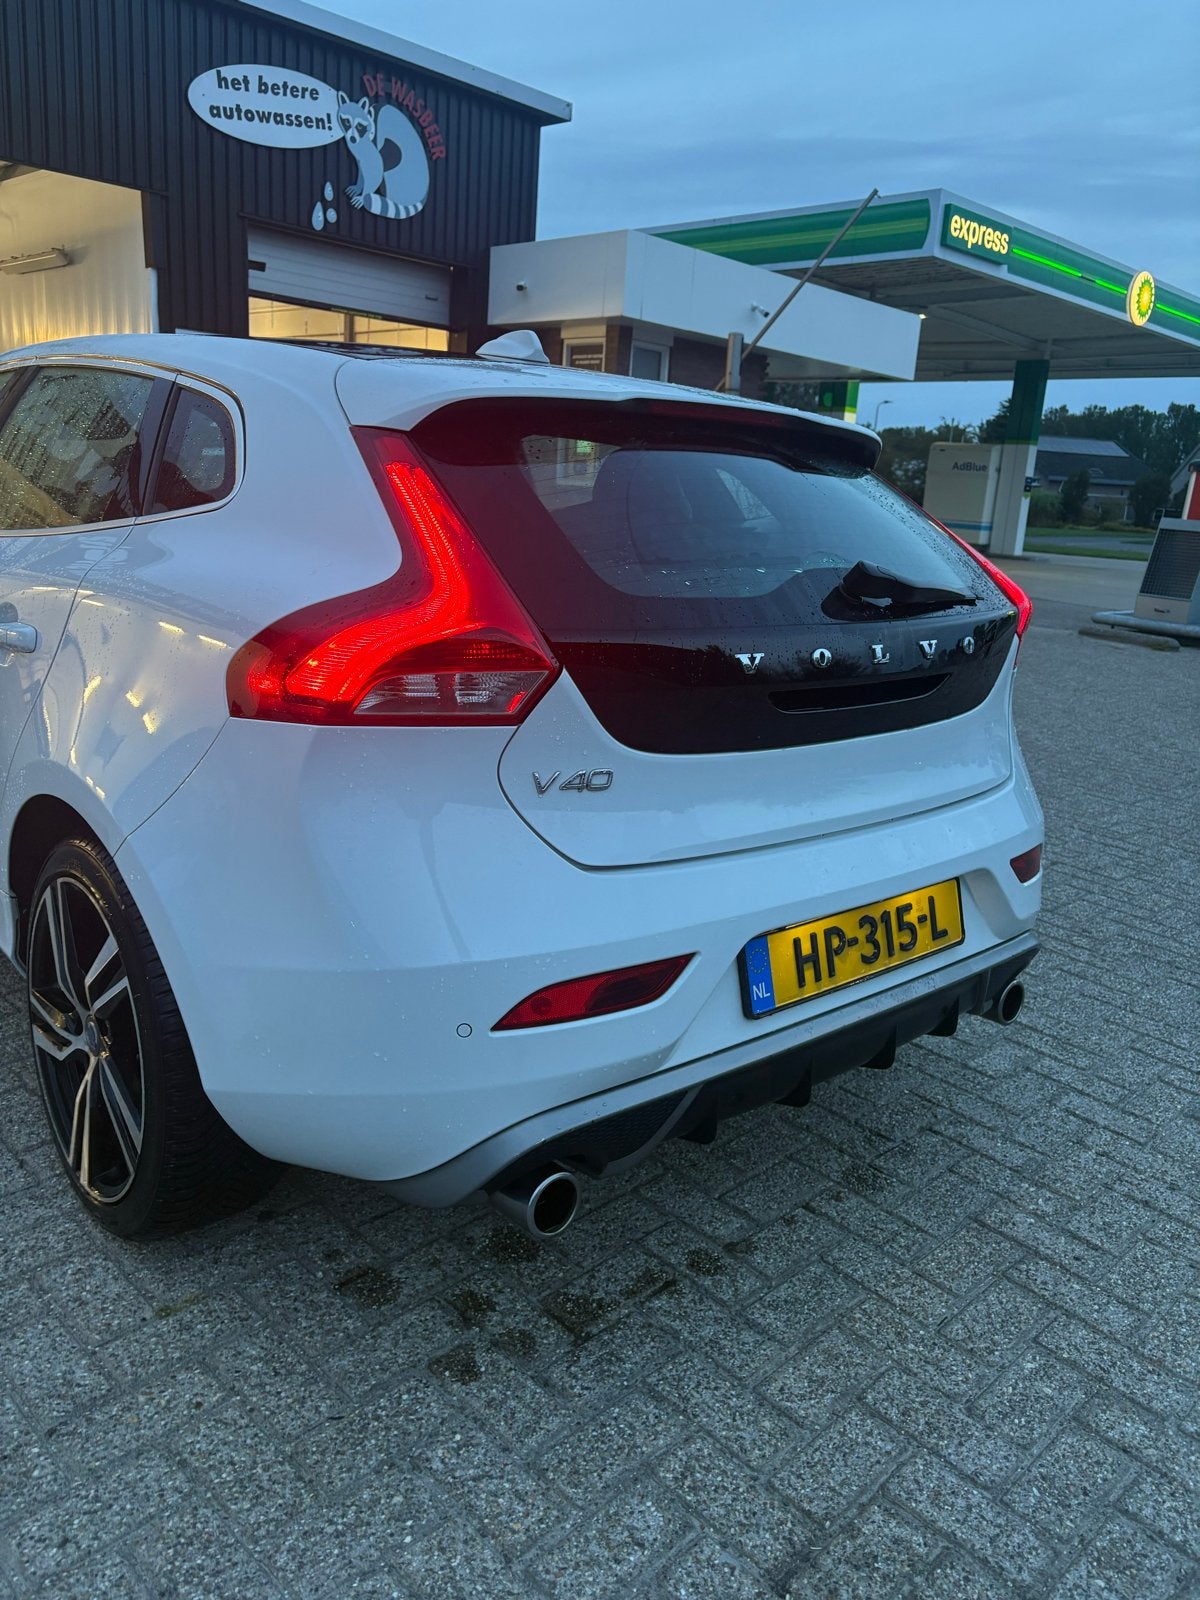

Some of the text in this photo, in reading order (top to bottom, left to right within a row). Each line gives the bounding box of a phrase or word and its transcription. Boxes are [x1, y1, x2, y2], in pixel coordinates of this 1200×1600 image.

[216, 69, 320, 101] het betere
[209, 103, 333, 131] autowassen!
[362, 73, 447, 160] DE WASBEER
[950, 214, 1009, 255] express
[952, 461, 988, 472] AdBlue
[735, 636, 975, 674] VOLVO
[532, 768, 613, 795] V40
[753, 895, 948, 1001] NL HP-315-L
